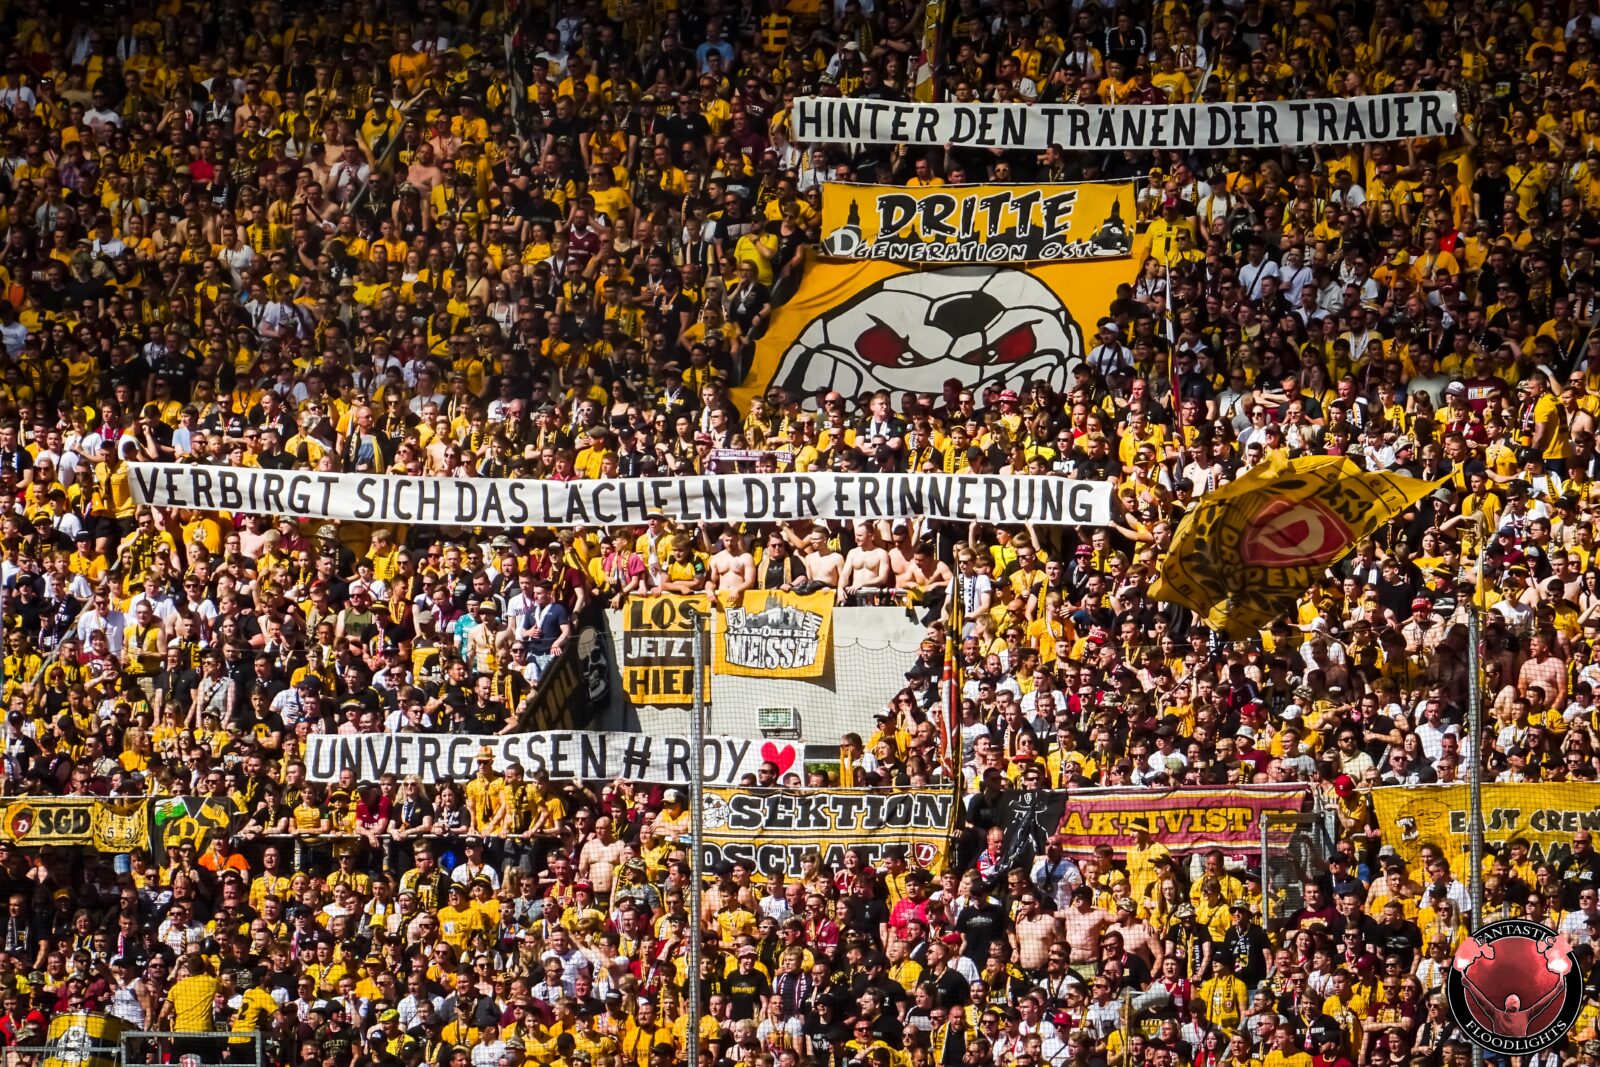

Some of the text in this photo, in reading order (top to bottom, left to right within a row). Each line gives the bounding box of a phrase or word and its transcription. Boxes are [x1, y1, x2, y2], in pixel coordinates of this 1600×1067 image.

[798, 94, 1454, 146] HINTER DEN TRÄNEN DER TRAUER,
[877, 190, 1078, 240] DRITTE
[853, 241, 1028, 262] GENERATION
[134, 467, 1094, 523] VERBIRGT SICH DAS LÄCHELN DER ERINNERUNG
[630, 598, 700, 629] LOS
[728, 625, 816, 638] LANDKREIS
[725, 633, 818, 668] MEISSEN
[39, 808, 91, 835] SGD
[729, 793, 953, 830] SEKTION
[1060, 807, 1252, 836] AKTIVIST
